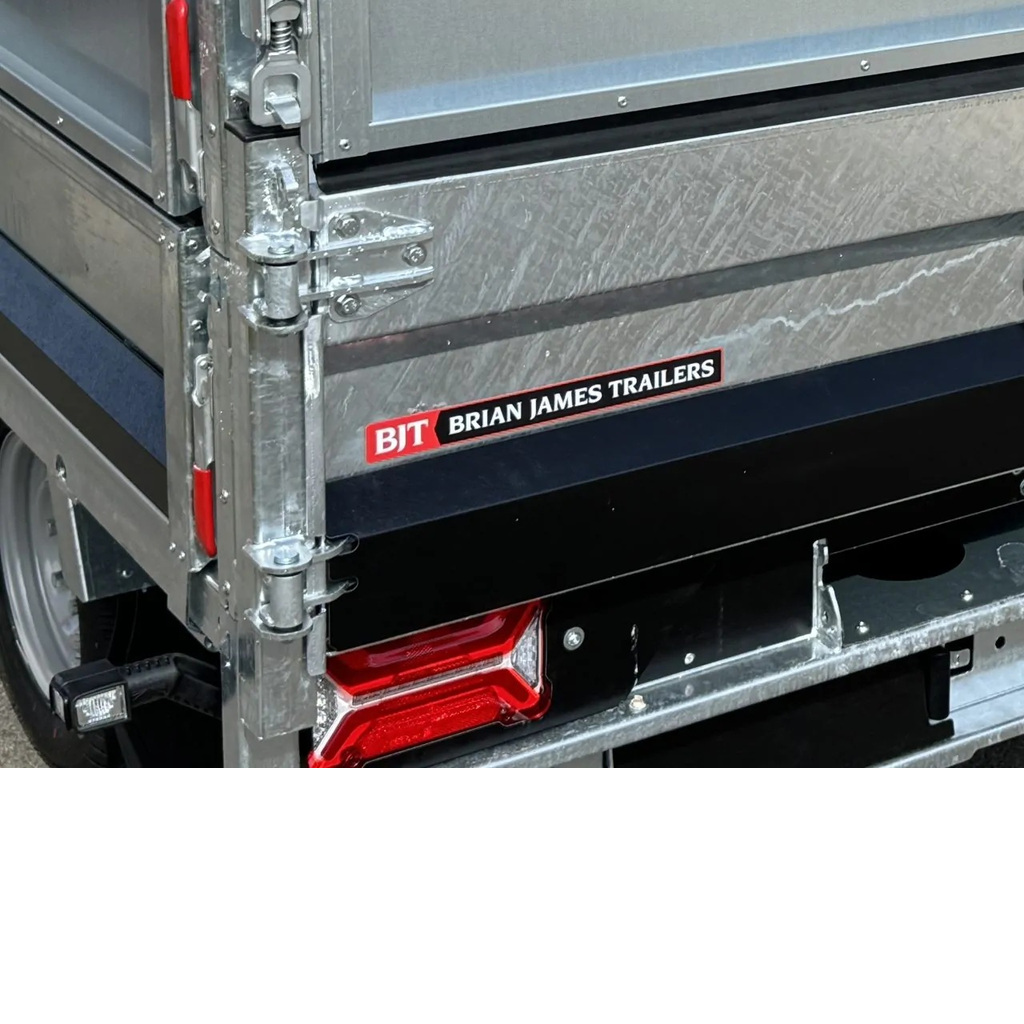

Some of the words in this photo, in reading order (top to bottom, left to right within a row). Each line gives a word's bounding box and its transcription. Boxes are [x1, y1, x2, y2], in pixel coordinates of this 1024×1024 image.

[448, 401, 522, 436] BRIAN
[529, 384, 602, 421] JAMES
[608, 358, 715, 399] TRAILERS
[374, 418, 429, 455] BJT
